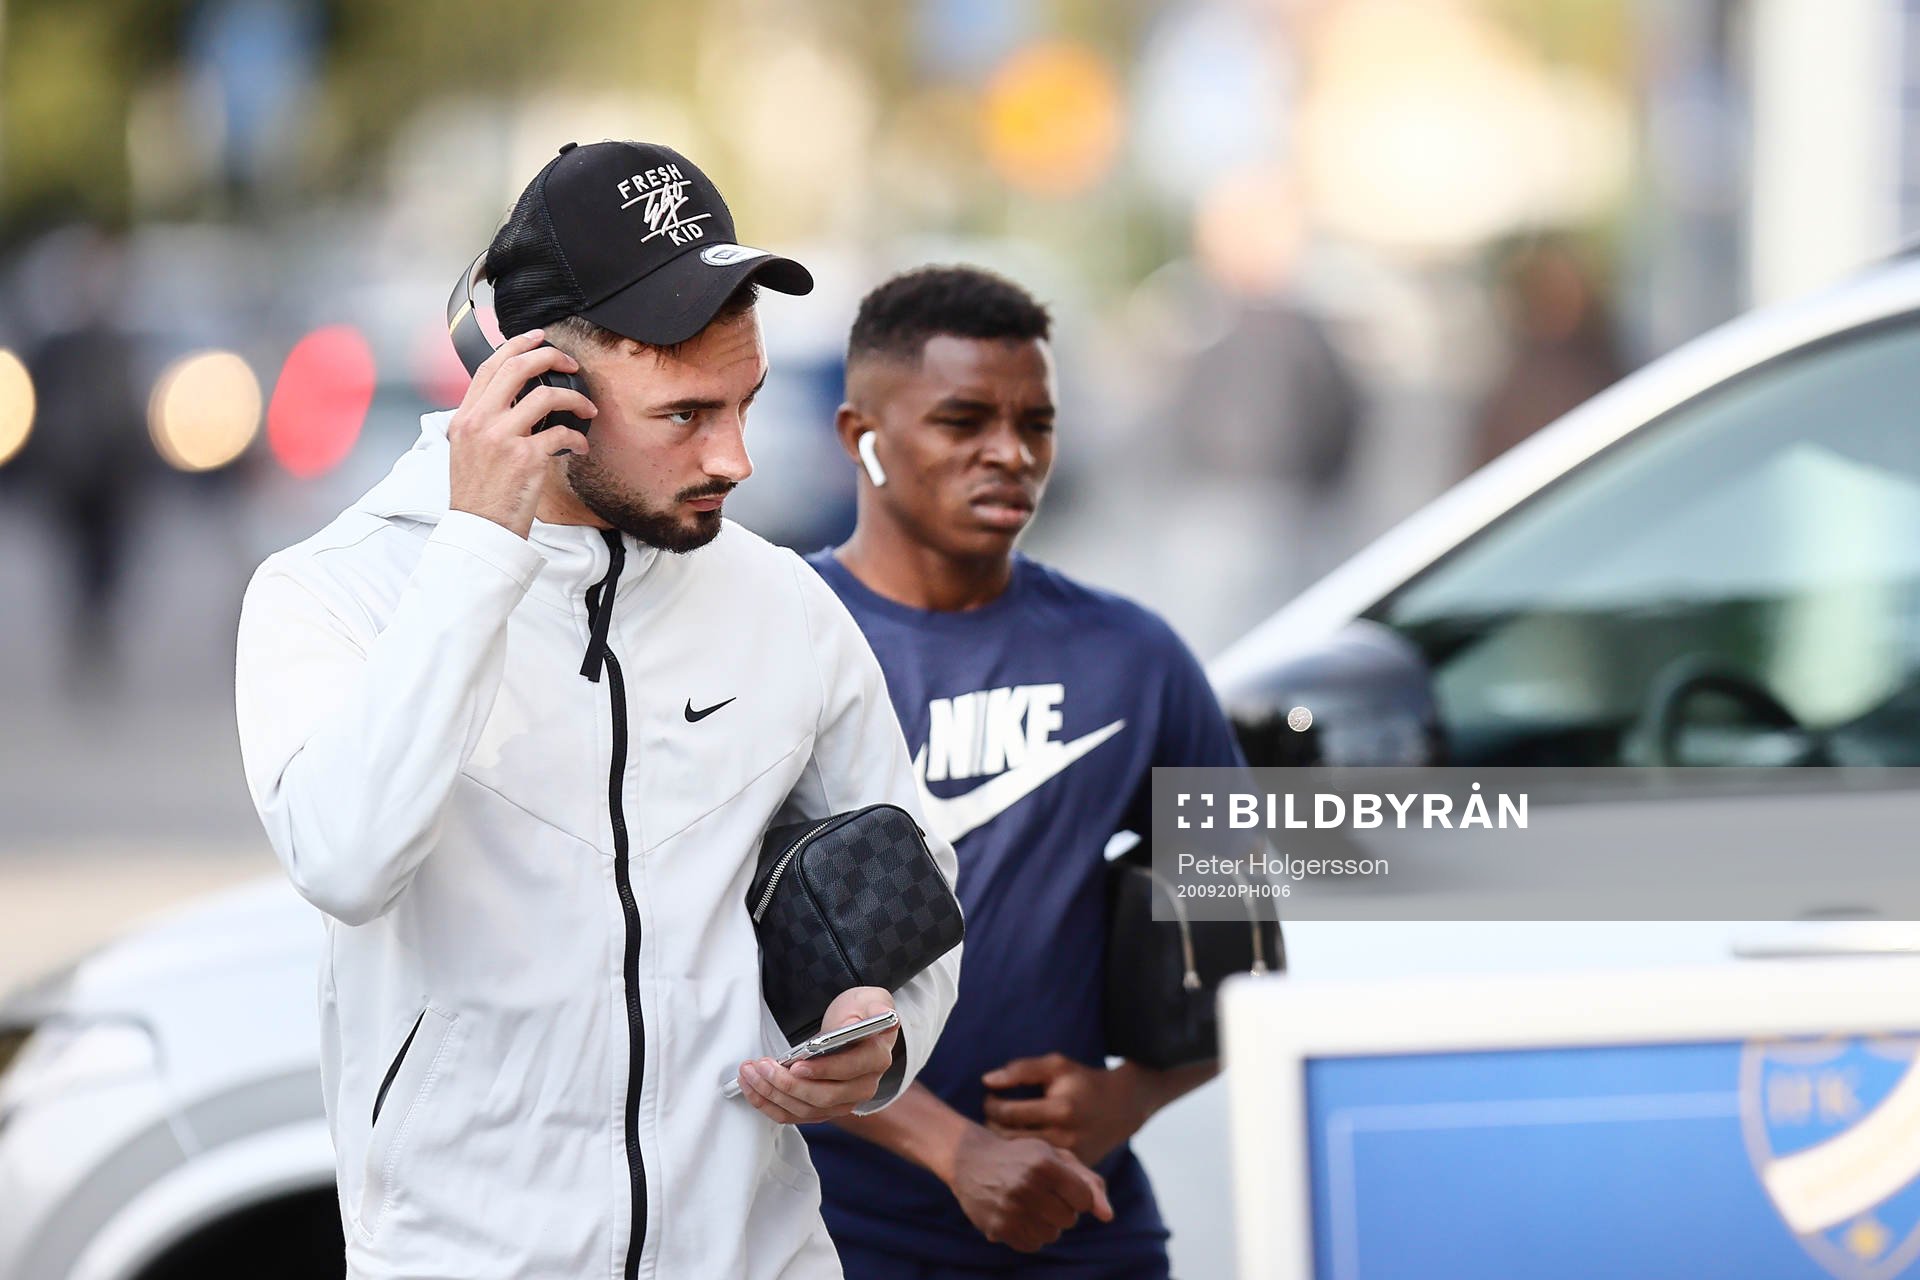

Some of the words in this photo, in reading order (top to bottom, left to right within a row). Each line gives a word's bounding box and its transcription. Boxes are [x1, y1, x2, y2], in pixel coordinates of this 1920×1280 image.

[617, 164, 683, 199] FRESH
[668, 223, 703, 246] KID
[926, 683, 1064, 781] NIKE
